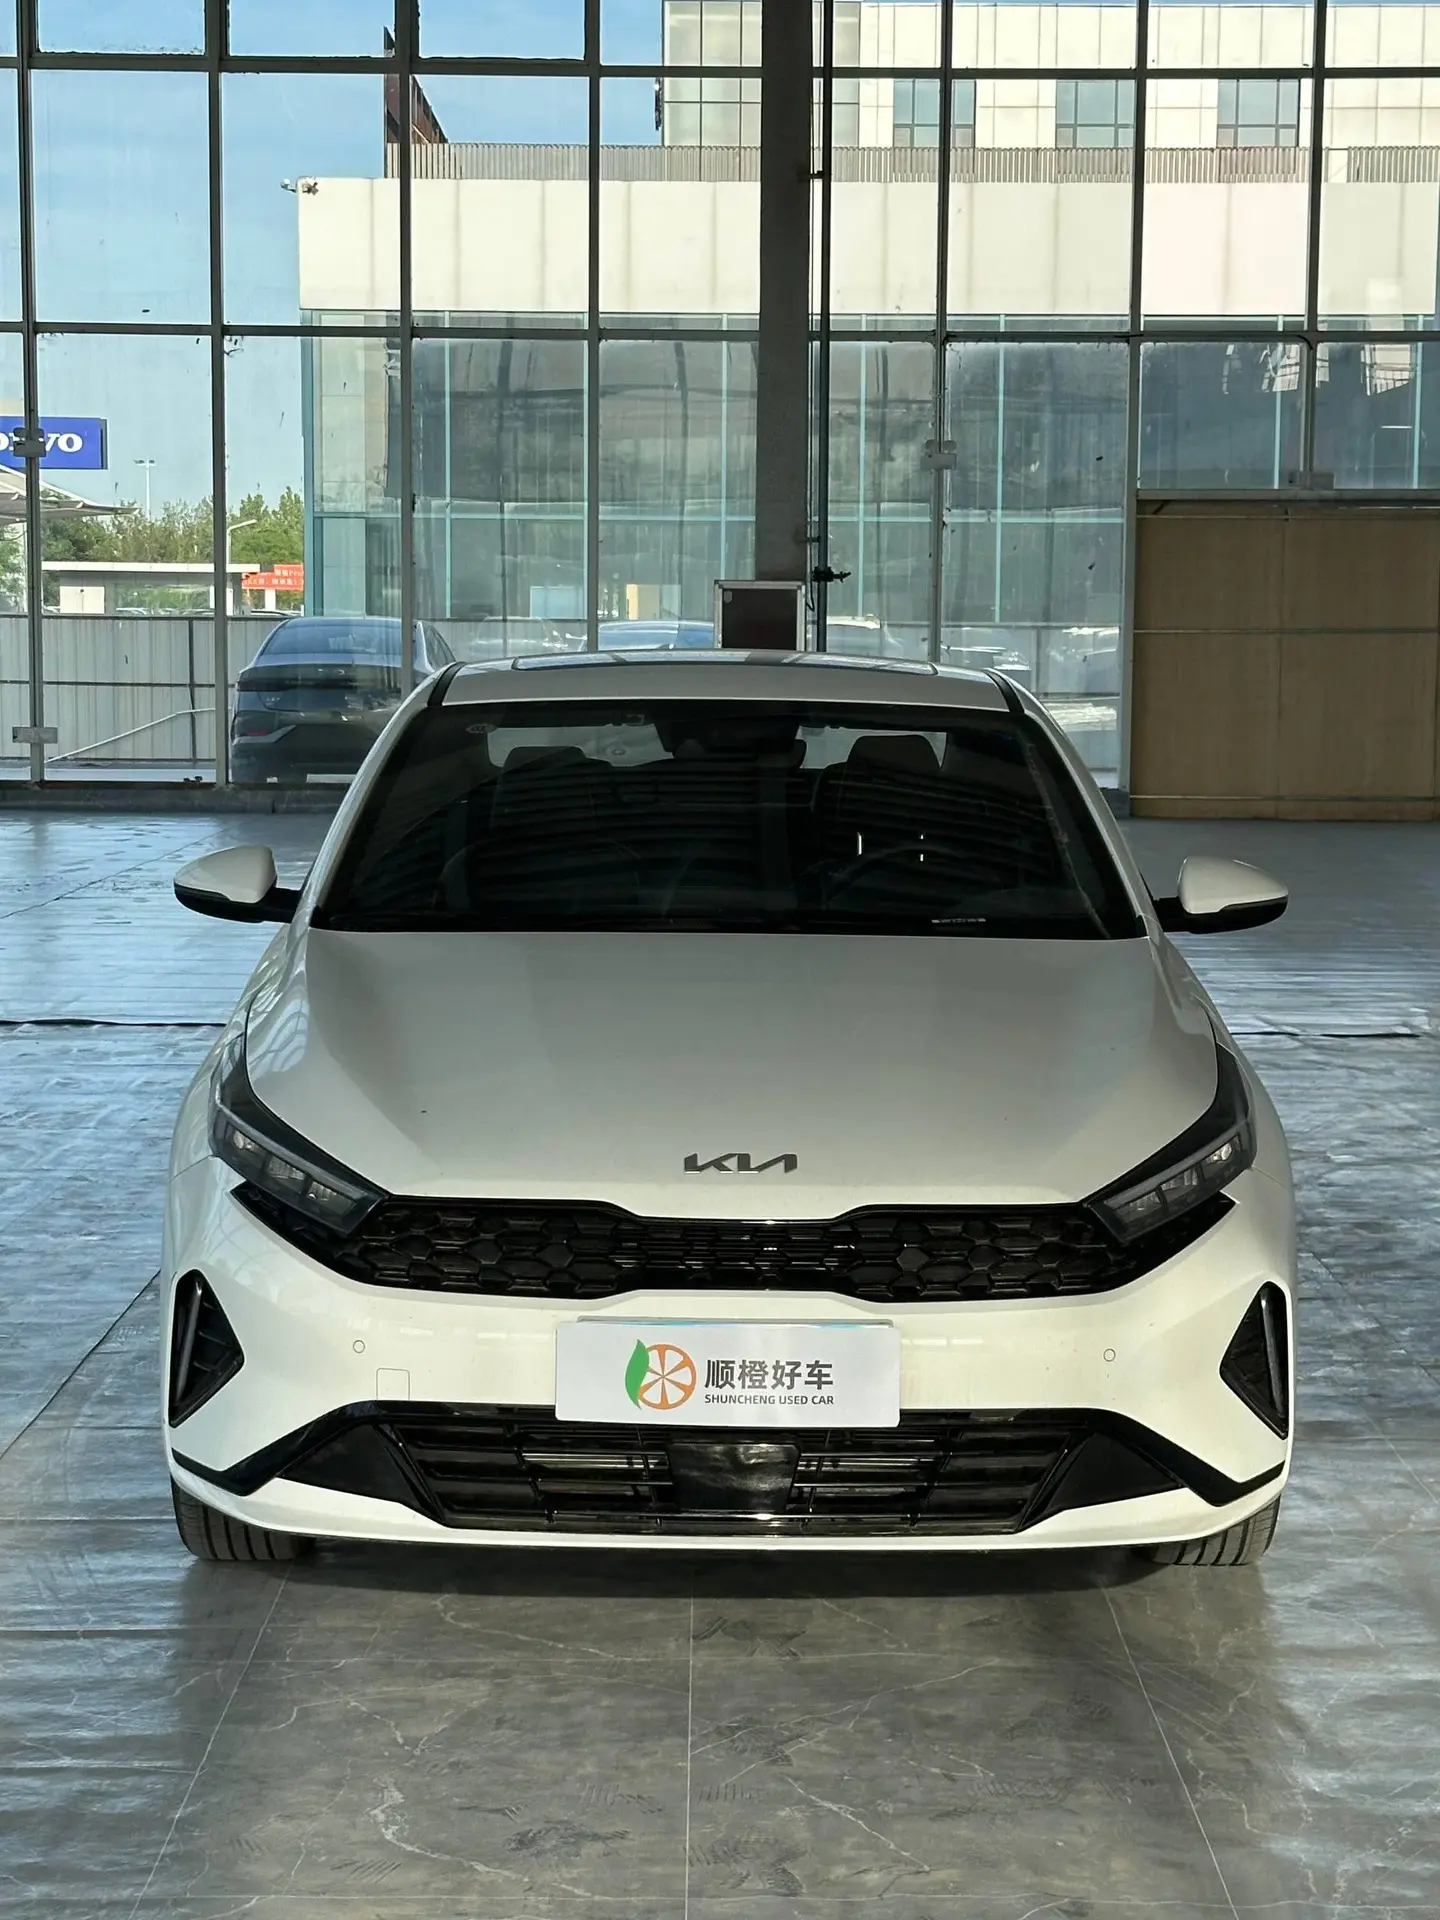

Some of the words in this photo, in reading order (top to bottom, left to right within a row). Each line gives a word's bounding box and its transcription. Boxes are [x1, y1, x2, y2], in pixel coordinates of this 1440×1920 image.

[684, 1152, 798, 1174] KIA
[704, 1359, 834, 1390] 顺橙好车
[704, 1394, 776, 1405] SHUNCHENG
[779, 1395, 808, 1405] USED
[811, 1396, 834, 1405] CAR
